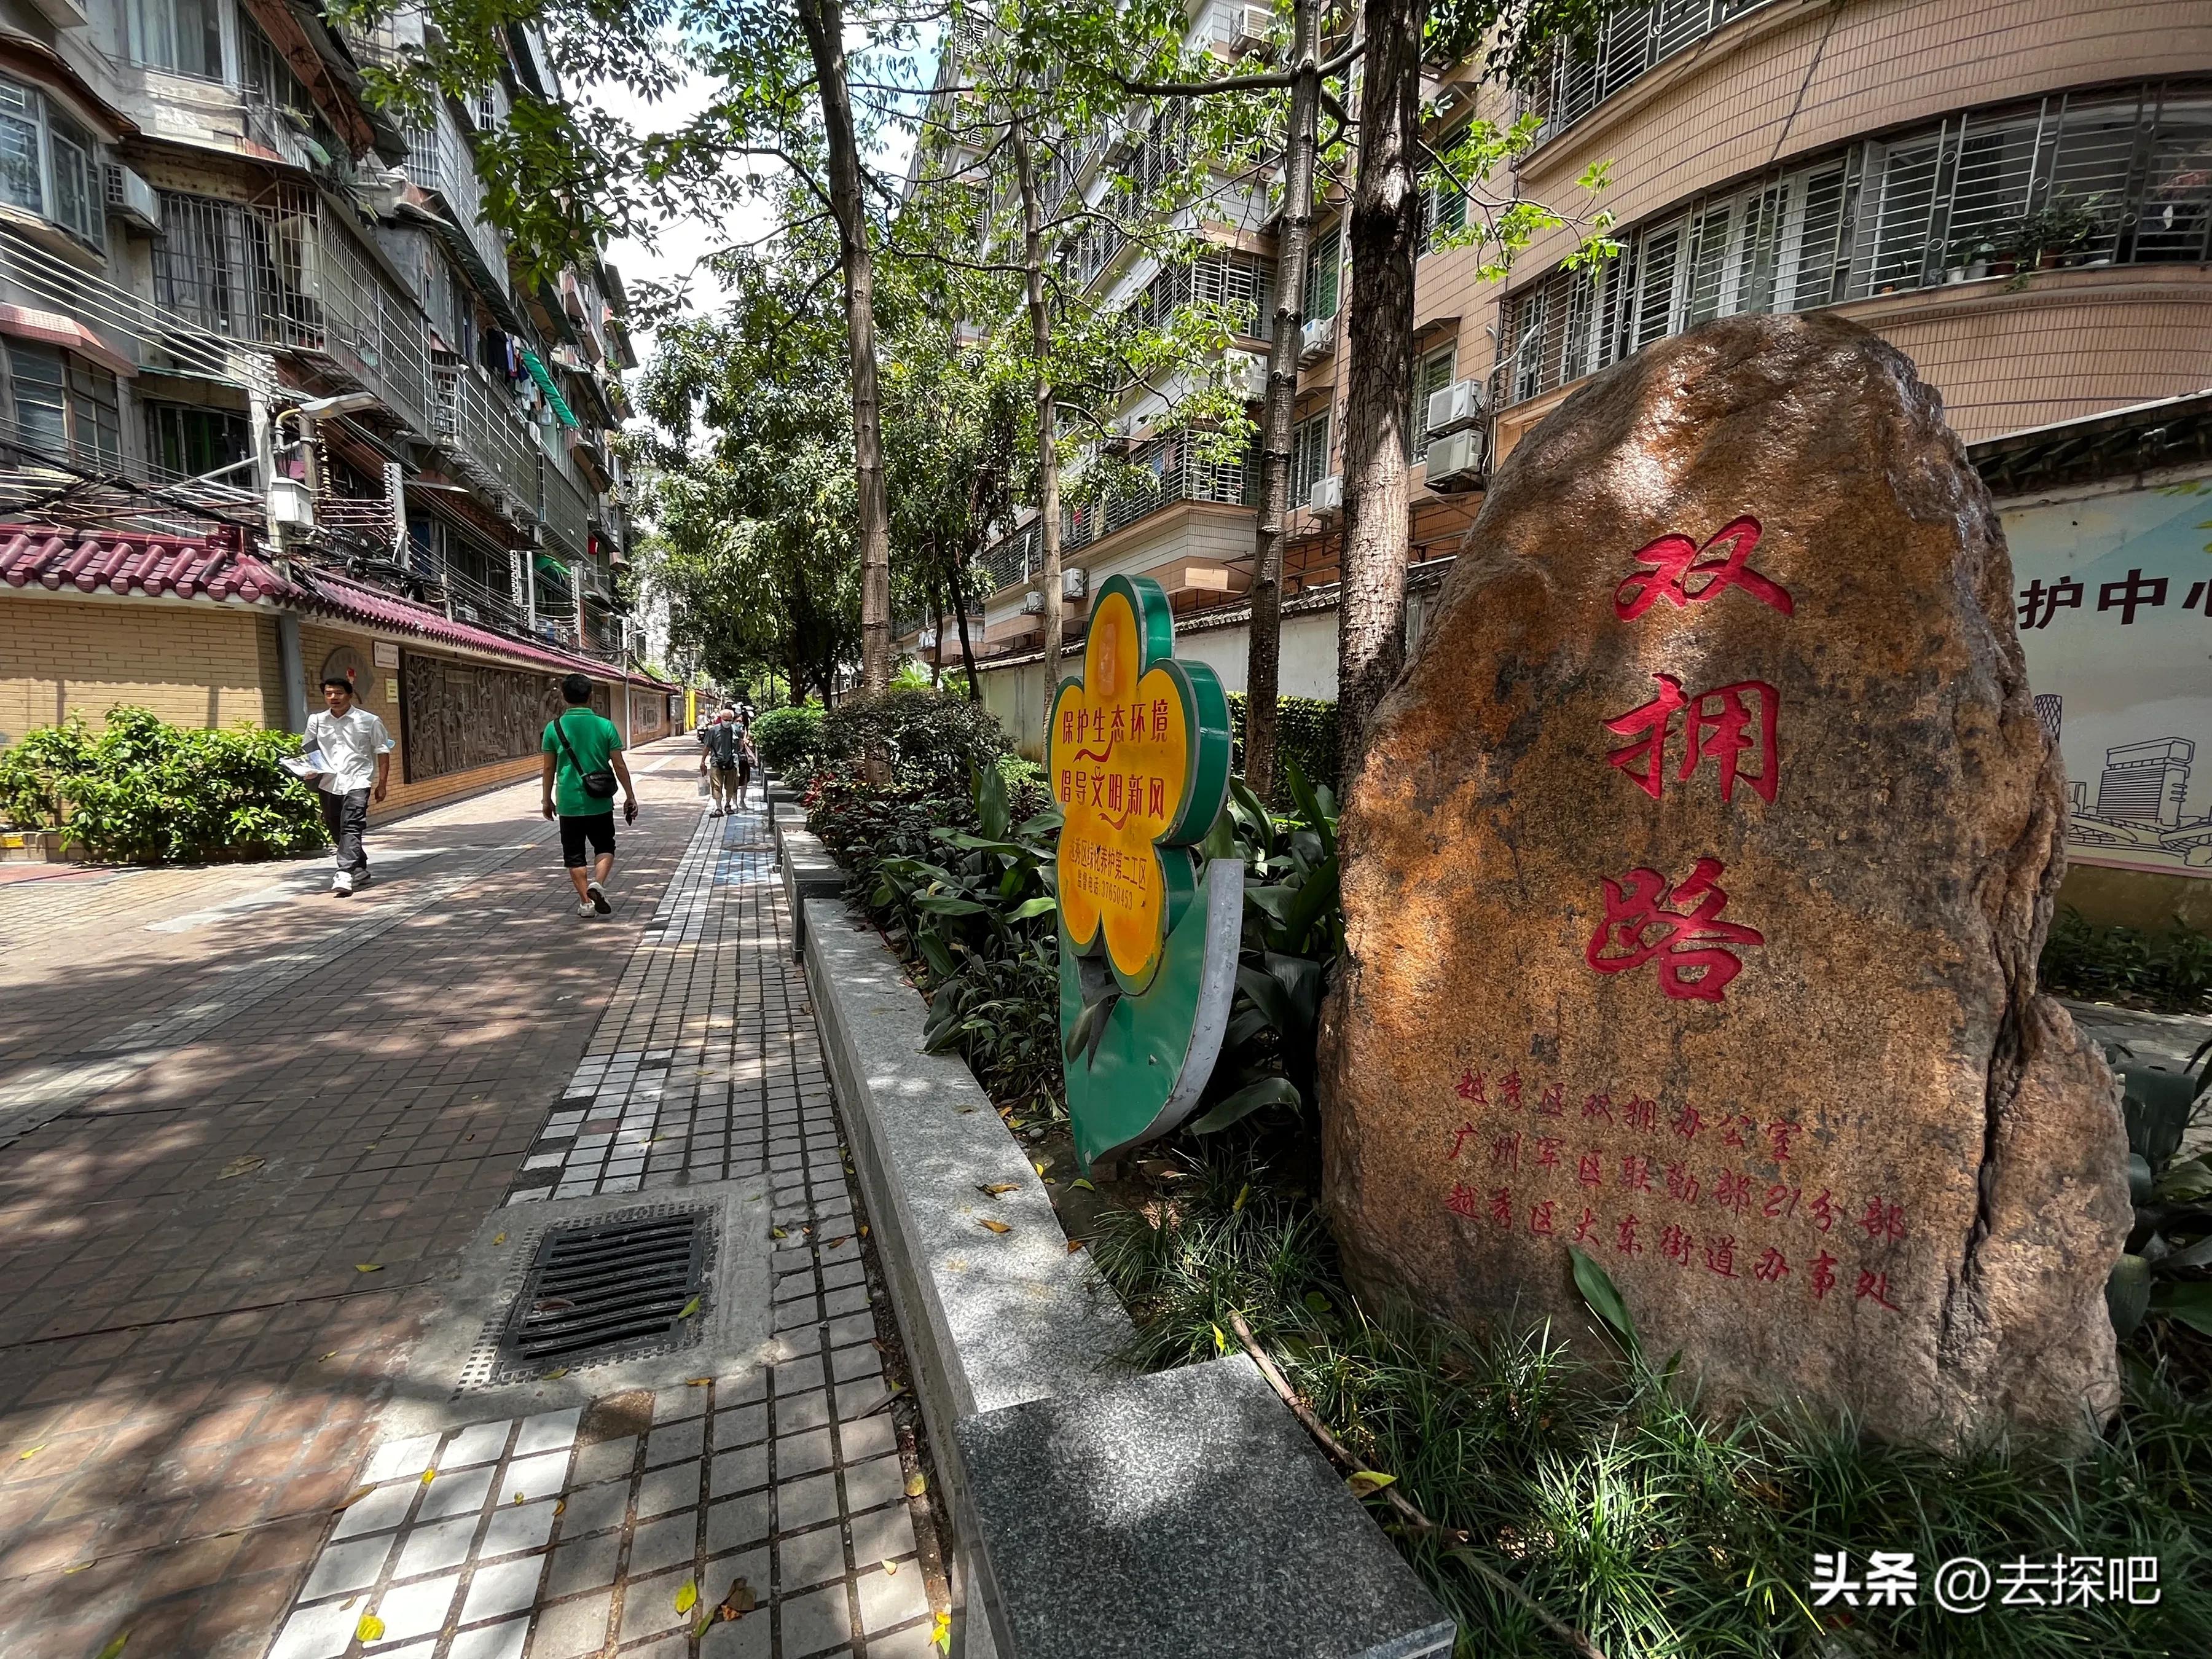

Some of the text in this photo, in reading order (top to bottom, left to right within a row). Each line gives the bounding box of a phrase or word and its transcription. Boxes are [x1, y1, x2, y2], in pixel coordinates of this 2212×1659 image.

[1062, 699, 1169, 745] 保护生态环境
[1586, 515, 1793, 1003] 双拥路
[1061, 766, 1164, 820] 倡导文明新风
[1453, 1067, 1802, 1163] 越秀区双拥办公室
[1447, 1120, 1905, 1243] 广州军区联勤部21分部
[1444, 1182, 1901, 1312] 越秀区大东街道办事处
